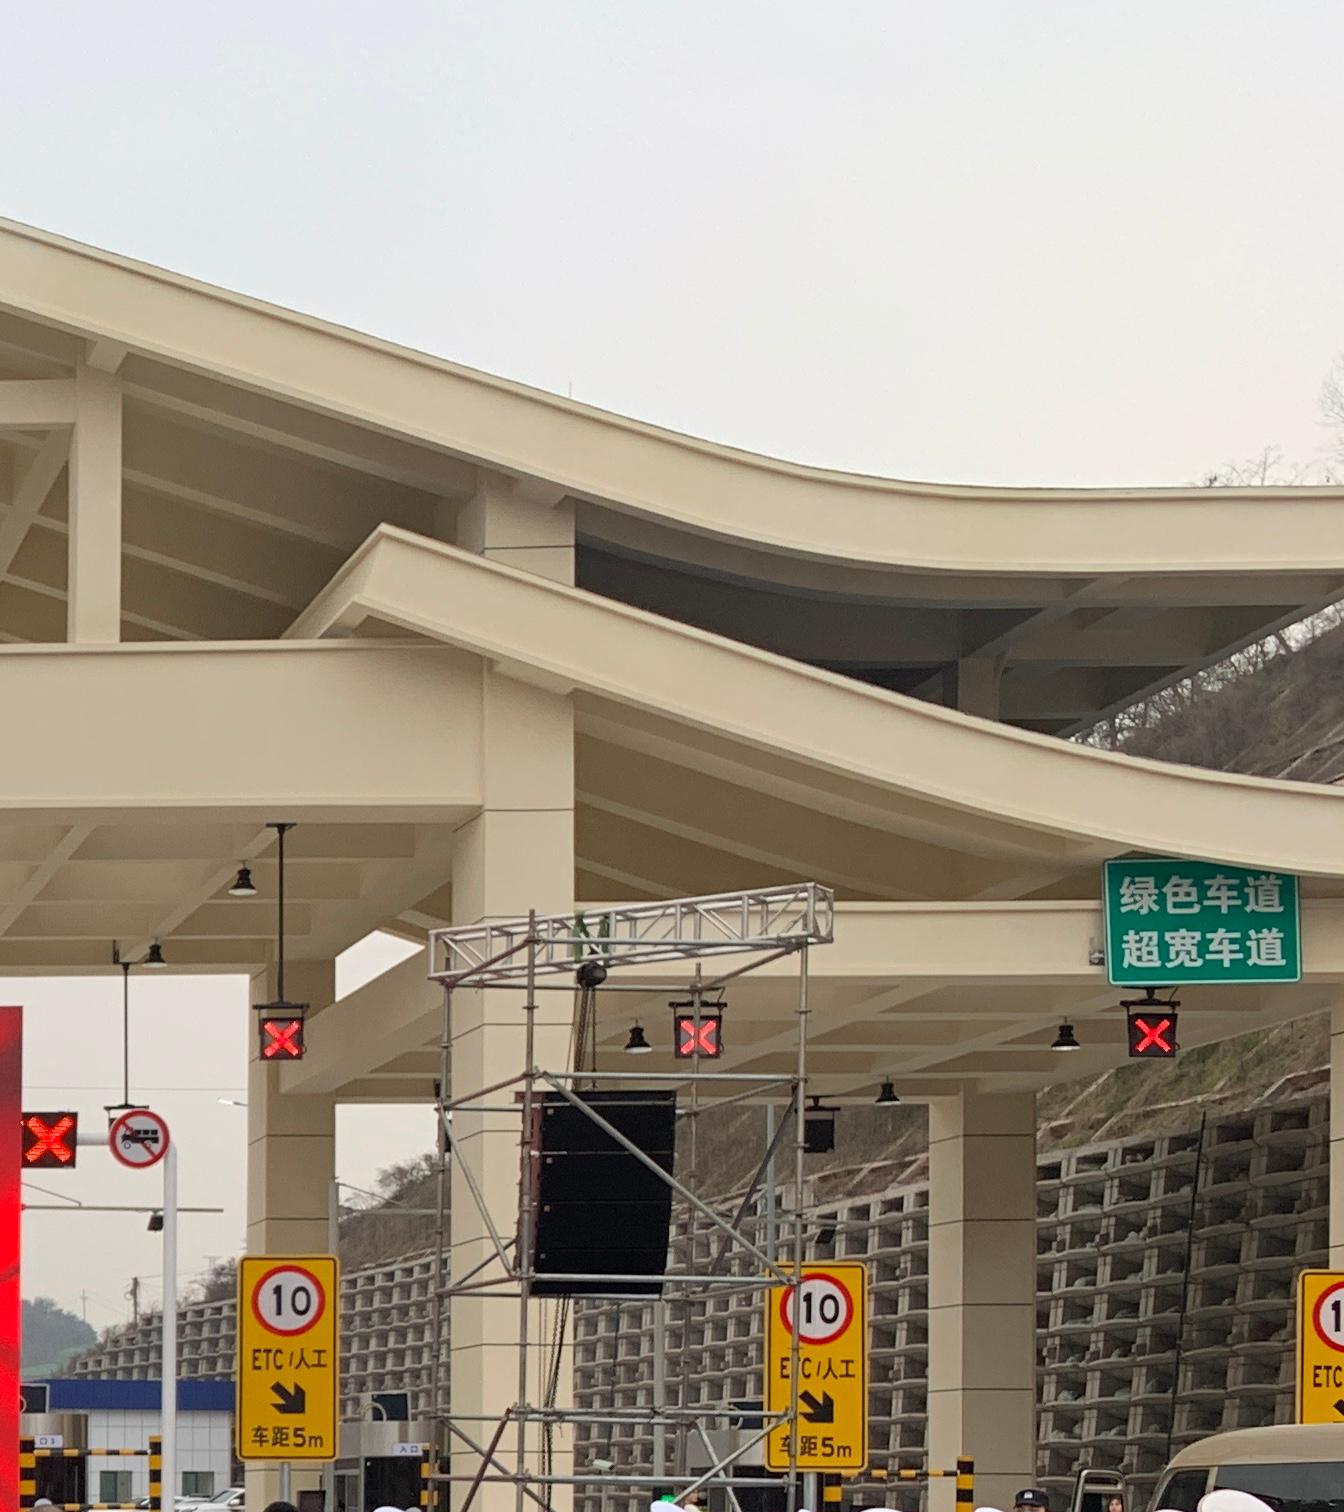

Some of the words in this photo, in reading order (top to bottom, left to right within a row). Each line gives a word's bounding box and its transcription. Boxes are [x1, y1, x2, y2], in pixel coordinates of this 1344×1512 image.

[1119, 874, 1286, 914] 绿色车道
[1120, 928, 1287, 969] 超宽车道
[272, 1284, 312, 1317] 10
[802, 1291, 840, 1325] 10
[780, 1357, 856, 1380] EC/人工
[1313, 1365, 1342, 1388] ETC
[251, 1425, 324, 1448] 车距5m
